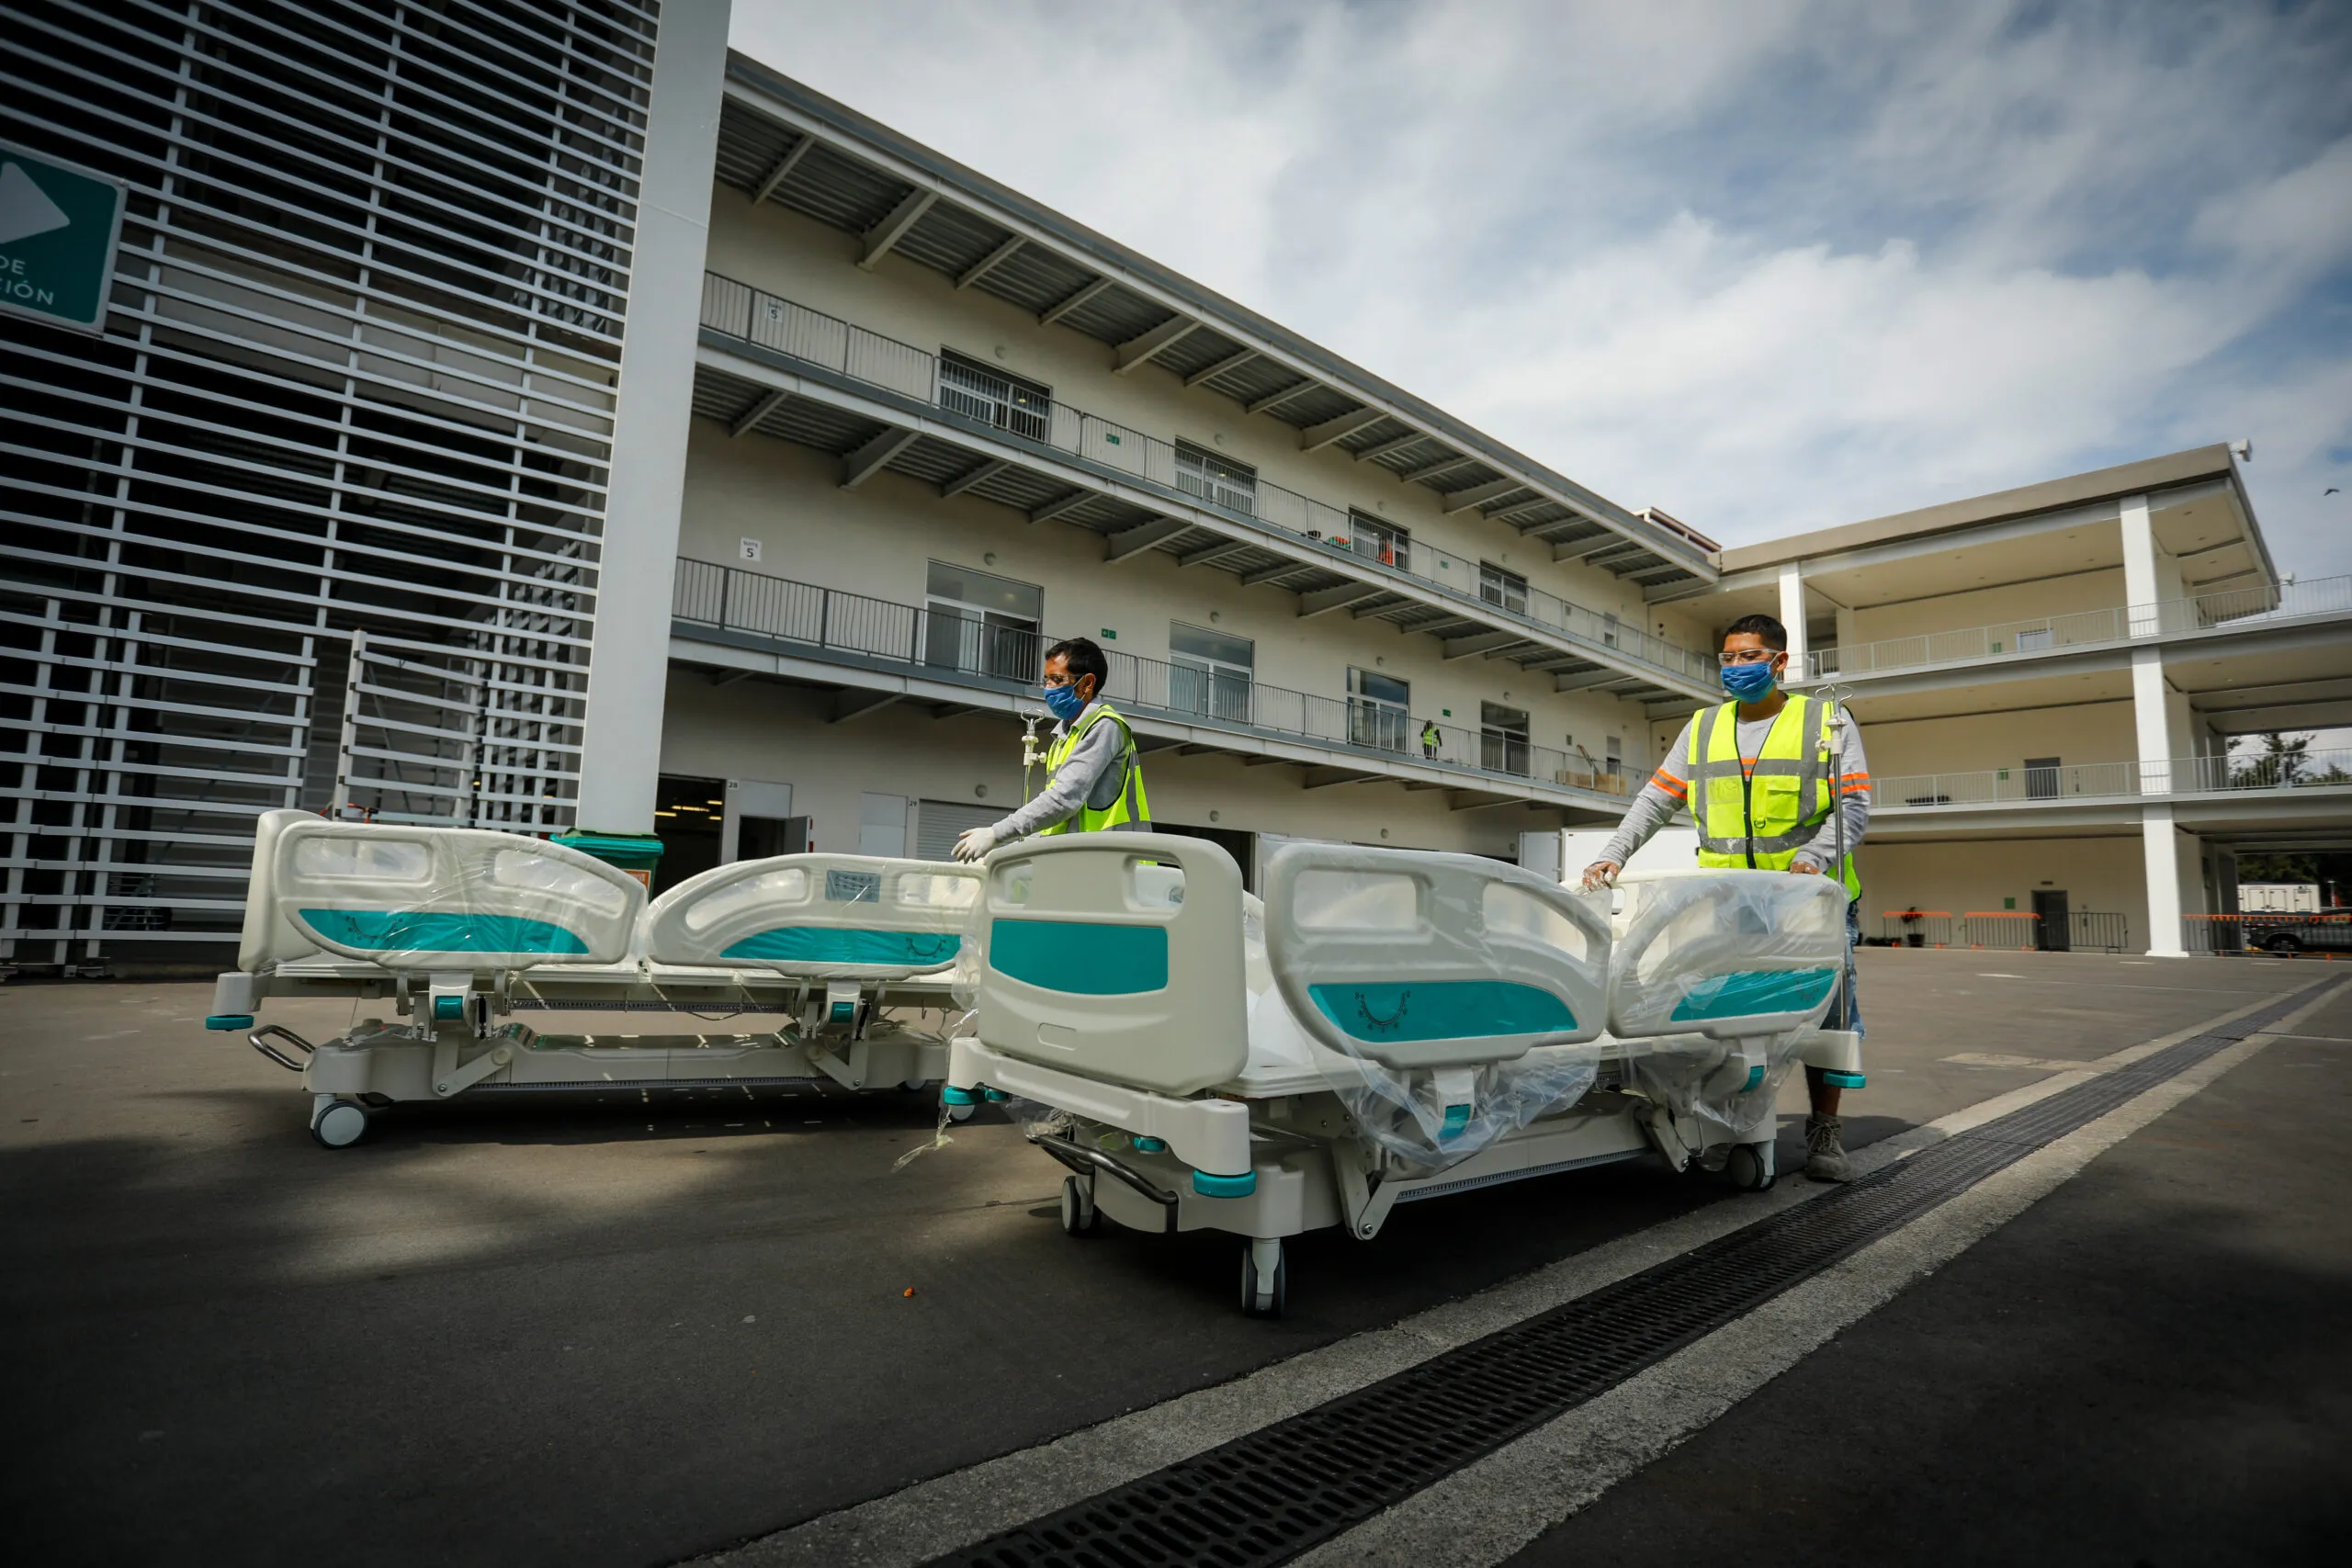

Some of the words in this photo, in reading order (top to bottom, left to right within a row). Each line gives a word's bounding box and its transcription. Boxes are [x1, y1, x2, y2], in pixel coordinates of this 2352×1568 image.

[0, 254, 26, 276] DE
[0, 278, 54, 306] IÓN
[746, 547, 753, 558] 5
